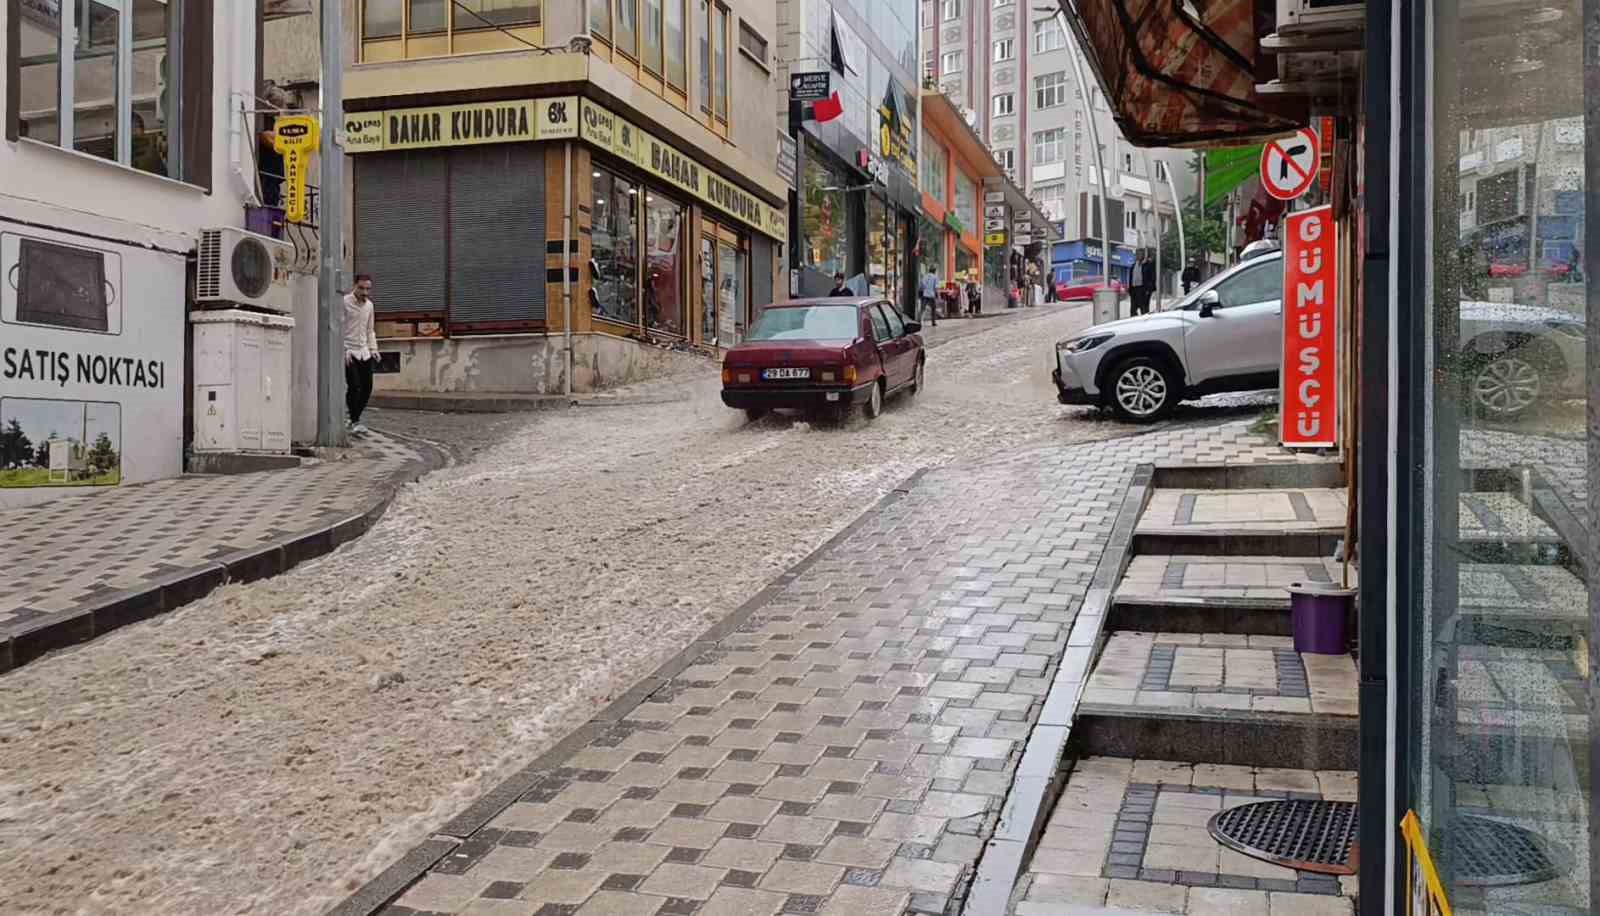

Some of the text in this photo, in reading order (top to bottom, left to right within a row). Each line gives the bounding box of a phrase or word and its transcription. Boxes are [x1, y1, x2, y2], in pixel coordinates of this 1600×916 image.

[390, 106, 529, 145] BAHAR KUNDURA
[651, 142, 699, 192] BAHAR
[707, 174, 762, 227] KUNDURA
[1296, 215, 1325, 437] GÜMÜŞÇÜ
[3, 347, 164, 389] SATIŞ NOKTASI
